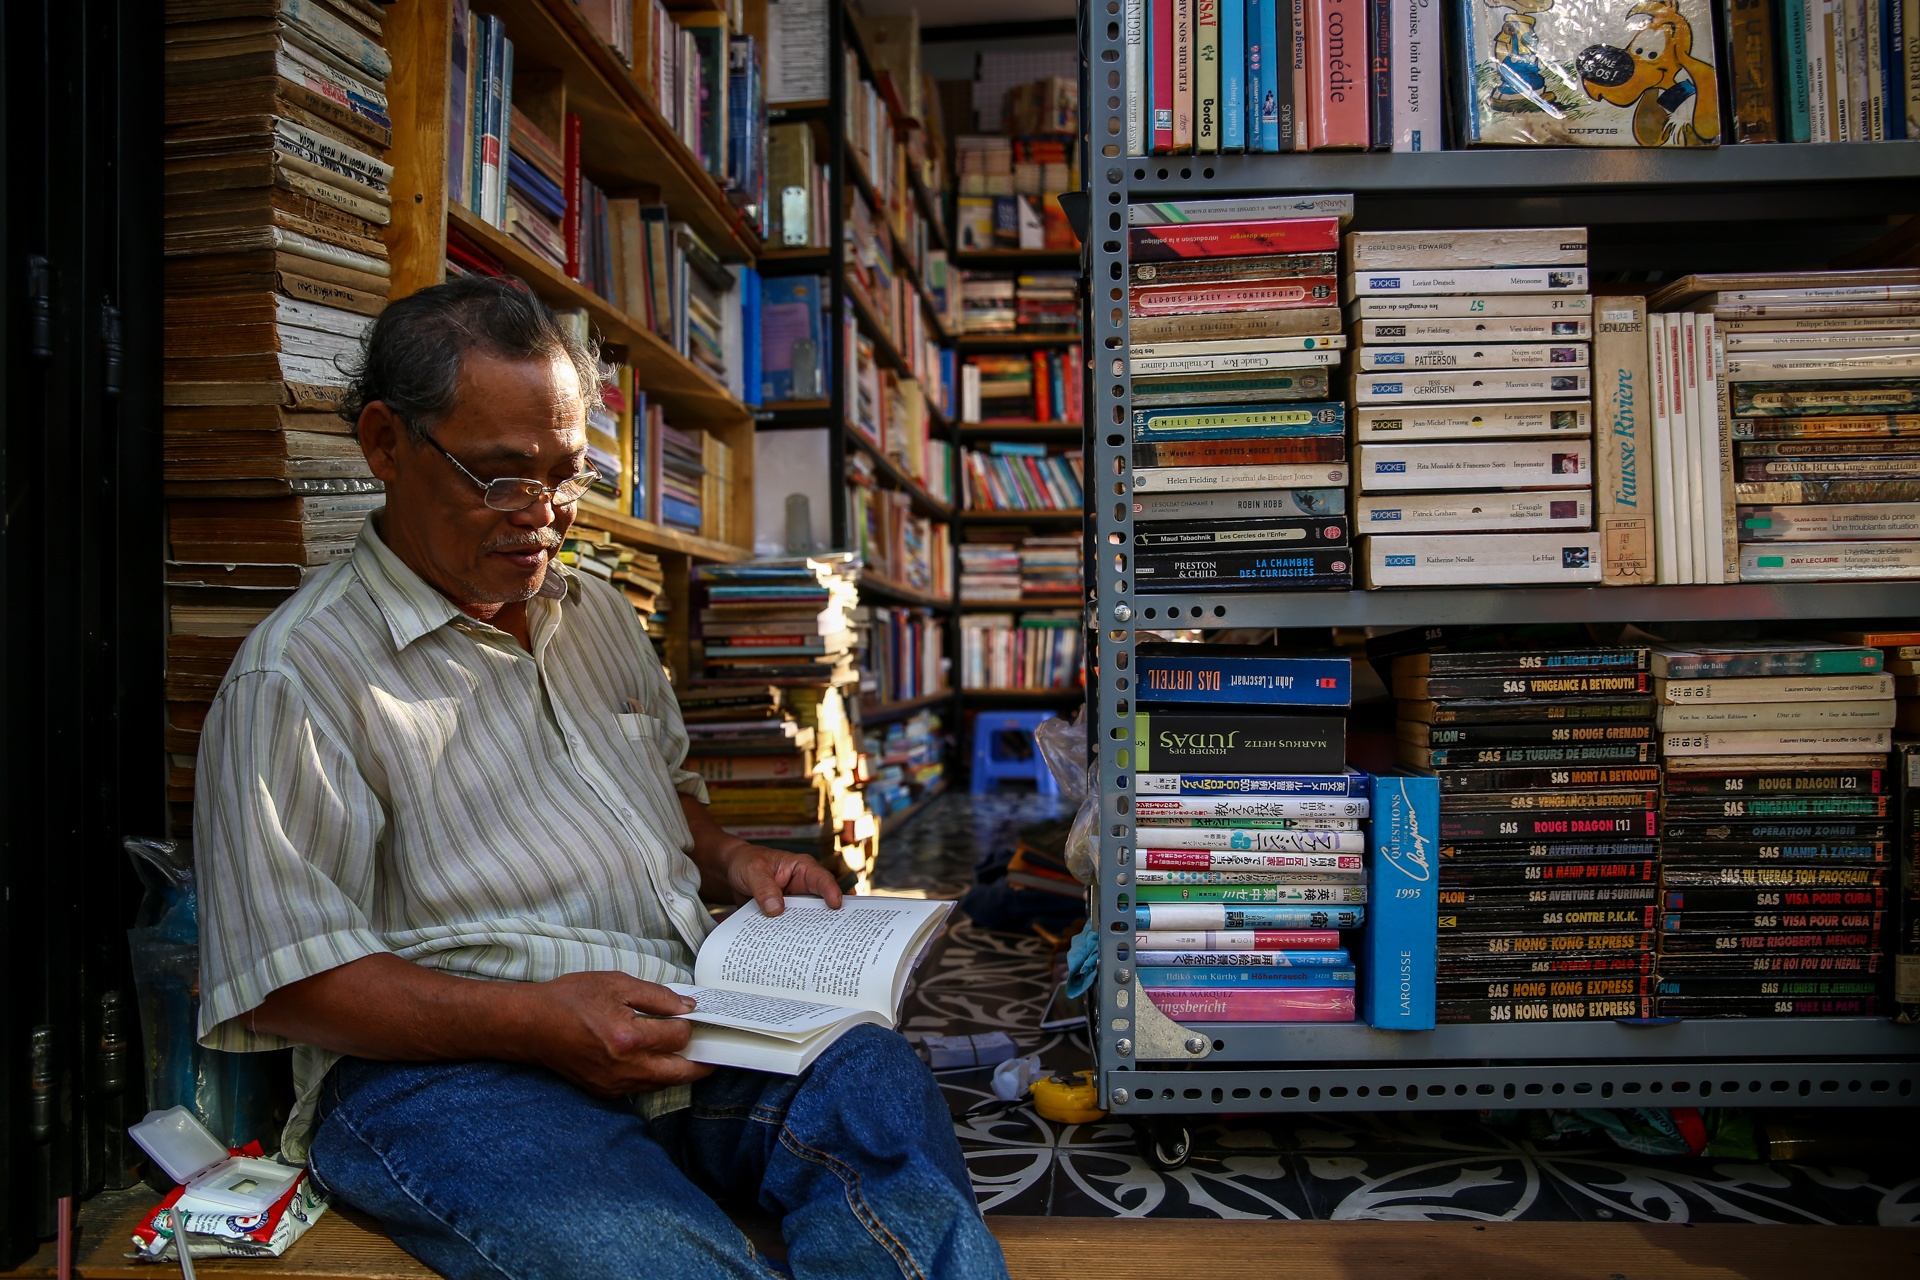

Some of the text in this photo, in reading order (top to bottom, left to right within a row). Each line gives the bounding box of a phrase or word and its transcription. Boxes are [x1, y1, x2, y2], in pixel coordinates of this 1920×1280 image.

[1793, 12, 1802, 54] CASTERMAN
[1294, 18, 1304, 69] Pansage et
[1329, 13, 1352, 102] comédie
[1408, 42, 1420, 112] loin du pays
[1228, 78, 1237, 137] Claude Fauque
[1202, 99, 1214, 136] Bordas
[1282, 104, 1291, 138] FLEURUS
[1141, 237, 1167, 245] politique
[1182, 235, 1219, 243] introduction
[1371, 280, 1400, 288] POCKET
[1511, 277, 1542, 285] Métronome
[1148, 290, 1299, 303] ALDOUS HUXLEY CONTREPOINT
[1204, 359, 1214, 368] Le
[1222, 358, 1238, 367] Roy
[1241, 357, 1268, 365] Claude
[1315, 354, 1328, 362] folio
[1415, 356, 1456, 365] PATTERSON
[1168, 360, 1201, 368] malheur
[1414, 386, 1454, 394] GERRITSEN
[1197, 417, 1225, 425] ZOLA
[1246, 413, 1308, 423] GERMINAL
[1413, 419, 1468, 427] Jean-Michel Truong
[1613, 369, 1638, 508] Fausse-Rivière
[1513, 461, 1544, 469] Imprimatur
[1774, 464, 1811, 472] PEARL
[1811, 463, 1842, 471] BUCK
[1869, 462, 1918, 471] combattant
[1190, 475, 1217, 484] Fielding
[1221, 475, 1229, 483] Le
[1231, 474, 1255, 484] journal
[1267, 473, 1291, 482] Bridget
[1293, 472, 1312, 480] Jones
[1238, 500, 1282, 509] ROBIN HOBB
[1892, 514, 1915, 522] prince
[1849, 523, 1886, 531] troublante
[1256, 558, 1314, 568] LA CHAMBRE
[1179, 570, 1217, 578] & CHILD
[1240, 567, 1314, 578] DES CURIOSITÉS
[1148, 670, 1220, 690] DAS URTEIL
[1230, 675, 1293, 689] John T. Lescroart
[1504, 678, 1634, 692] SAS VENGEANCE A BEYROUTH
[1432, 731, 1458, 742] PLON
[1552, 727, 1649, 739] SAS ROUGE GRENADE
[1160, 731, 1239, 748] JUDAS
[1279, 740, 1326, 748] MARKUS
[1214, 803, 1284, 817] 教える技術
[1381, 777, 1430, 881] Champion
[1392, 794, 1401, 859] QUESTIONS
[1500, 823, 1517, 833] SAS
[1534, 821, 1567, 833] ROUGE
[1571, 820, 1613, 832] DRAGON
[1222, 888, 1276, 900] 集中ゼミ
[1395, 888, 1420, 898] 1995
[1757, 893, 1872, 905] SAS VISA POUR CUBA
[1543, 912, 1638, 923] SAS CONTRE P.K.K.
[1211, 972, 1237, 982] Kürthy
[1401, 950, 1410, 1016] LAROUSSE
[1490, 1001, 1635, 1020] SAS HONG KONG EXPRESS
